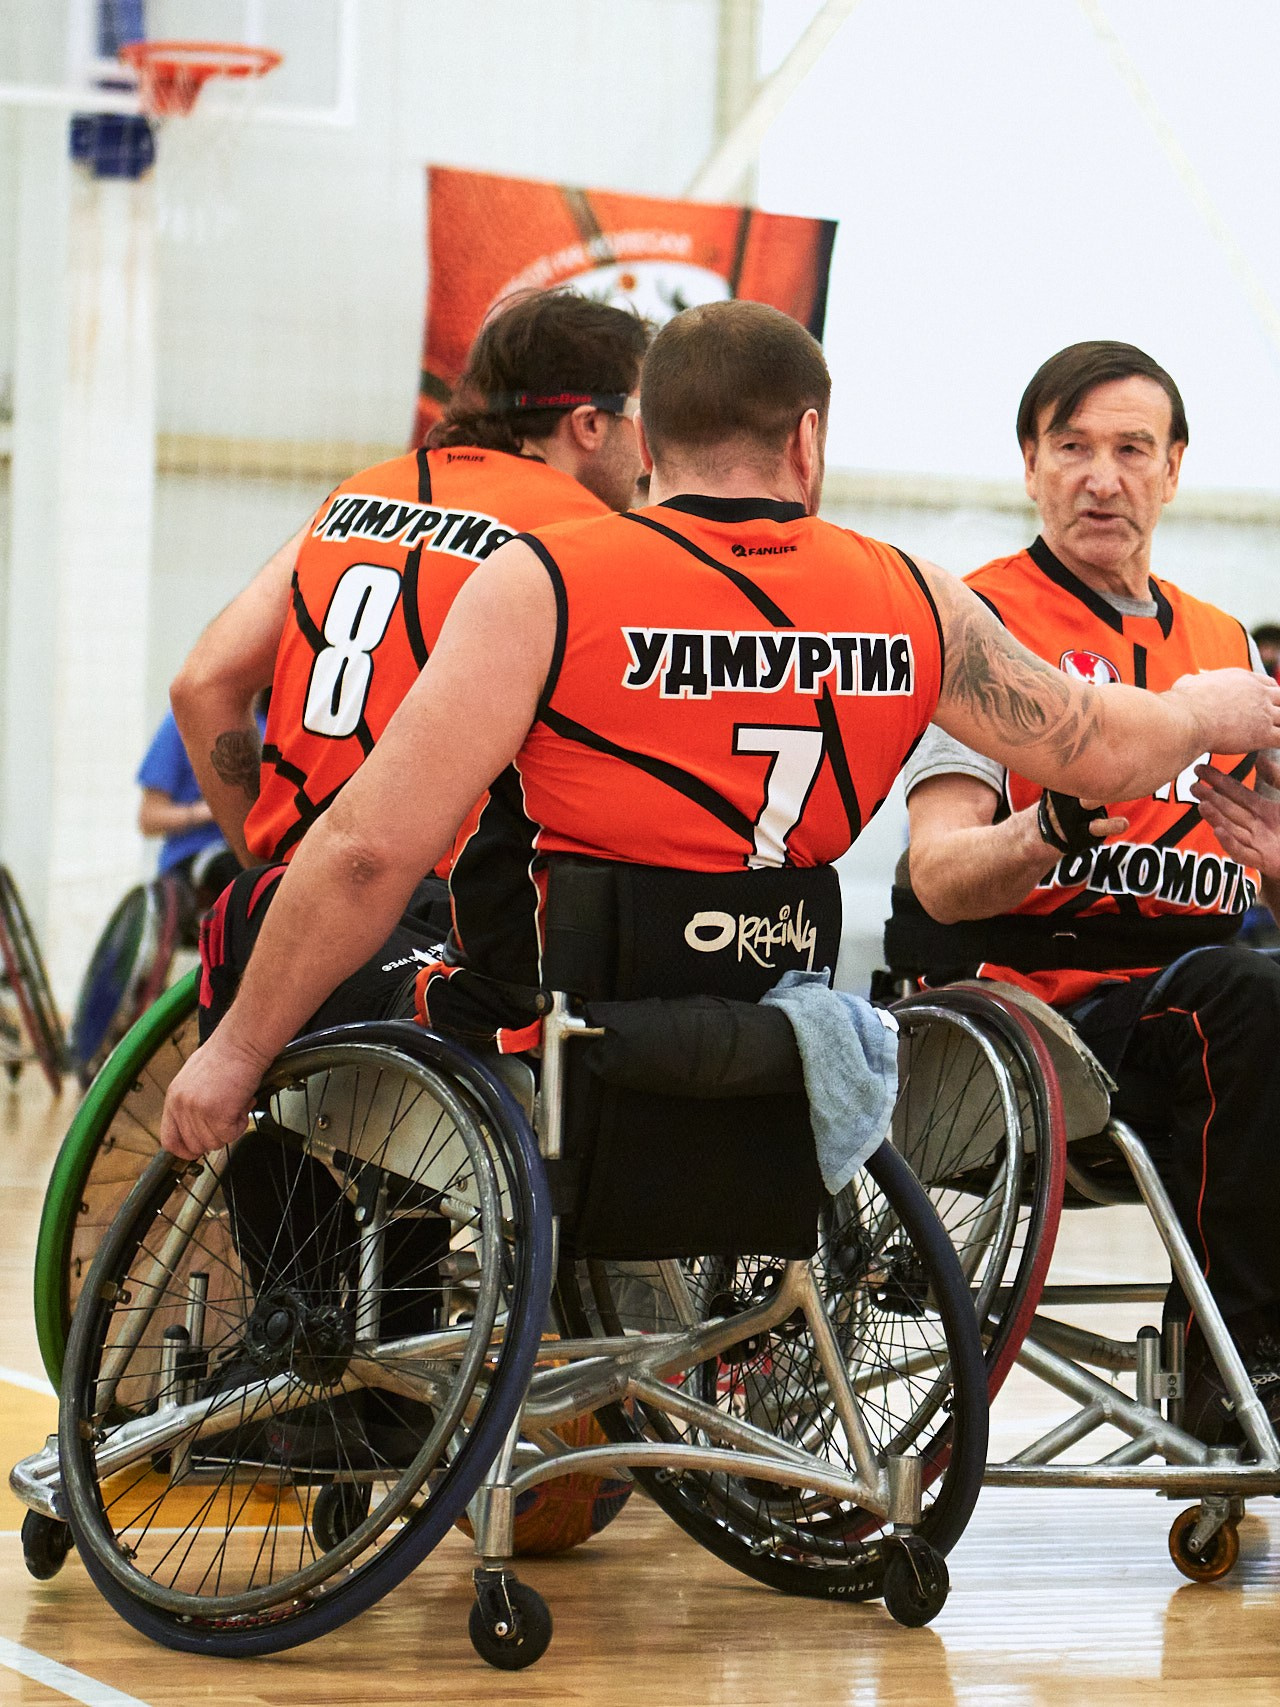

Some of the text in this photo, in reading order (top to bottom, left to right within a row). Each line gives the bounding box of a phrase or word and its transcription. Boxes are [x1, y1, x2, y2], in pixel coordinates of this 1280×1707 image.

[314, 496, 516, 561] УДМУРТИЯ
[748, 545, 797, 555] FANLIFE
[304, 564, 401, 737] 8
[624, 629, 912, 697] УДМУРТИЯ
[736, 727, 823, 870] 7
[828, 1580, 874, 1593] KENDA
